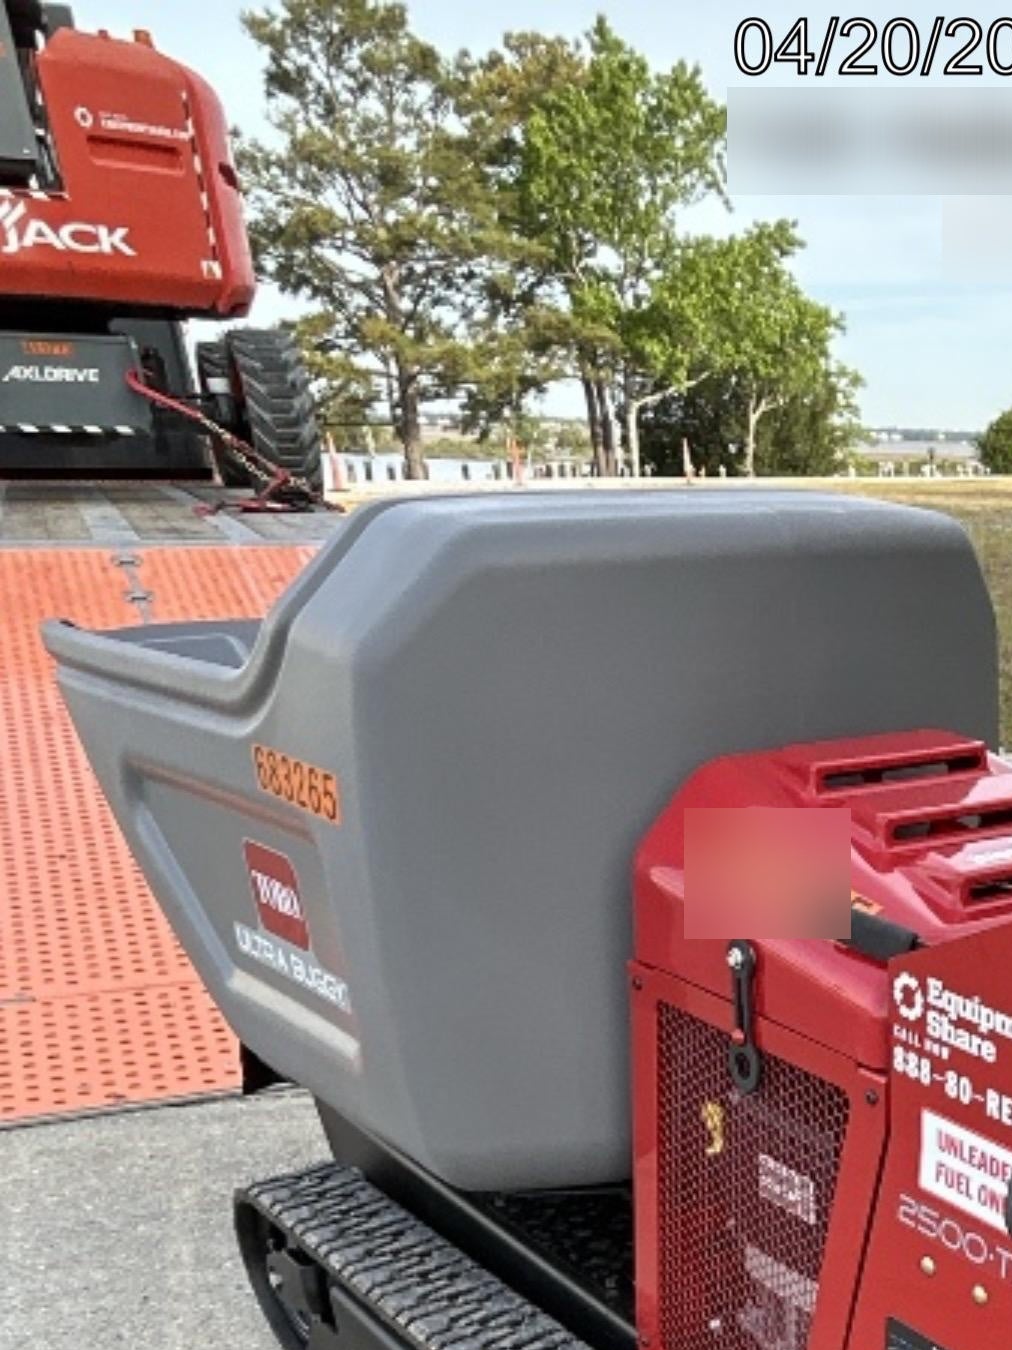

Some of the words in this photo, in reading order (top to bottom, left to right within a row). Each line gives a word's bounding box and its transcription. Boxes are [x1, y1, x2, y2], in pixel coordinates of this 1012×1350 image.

[253, 746, 337, 821] 683265
[926, 1011, 997, 1063] Share
[935, 1160, 973, 1201] FUEL
[936, 1128, 1011, 1184] UNLEADE
